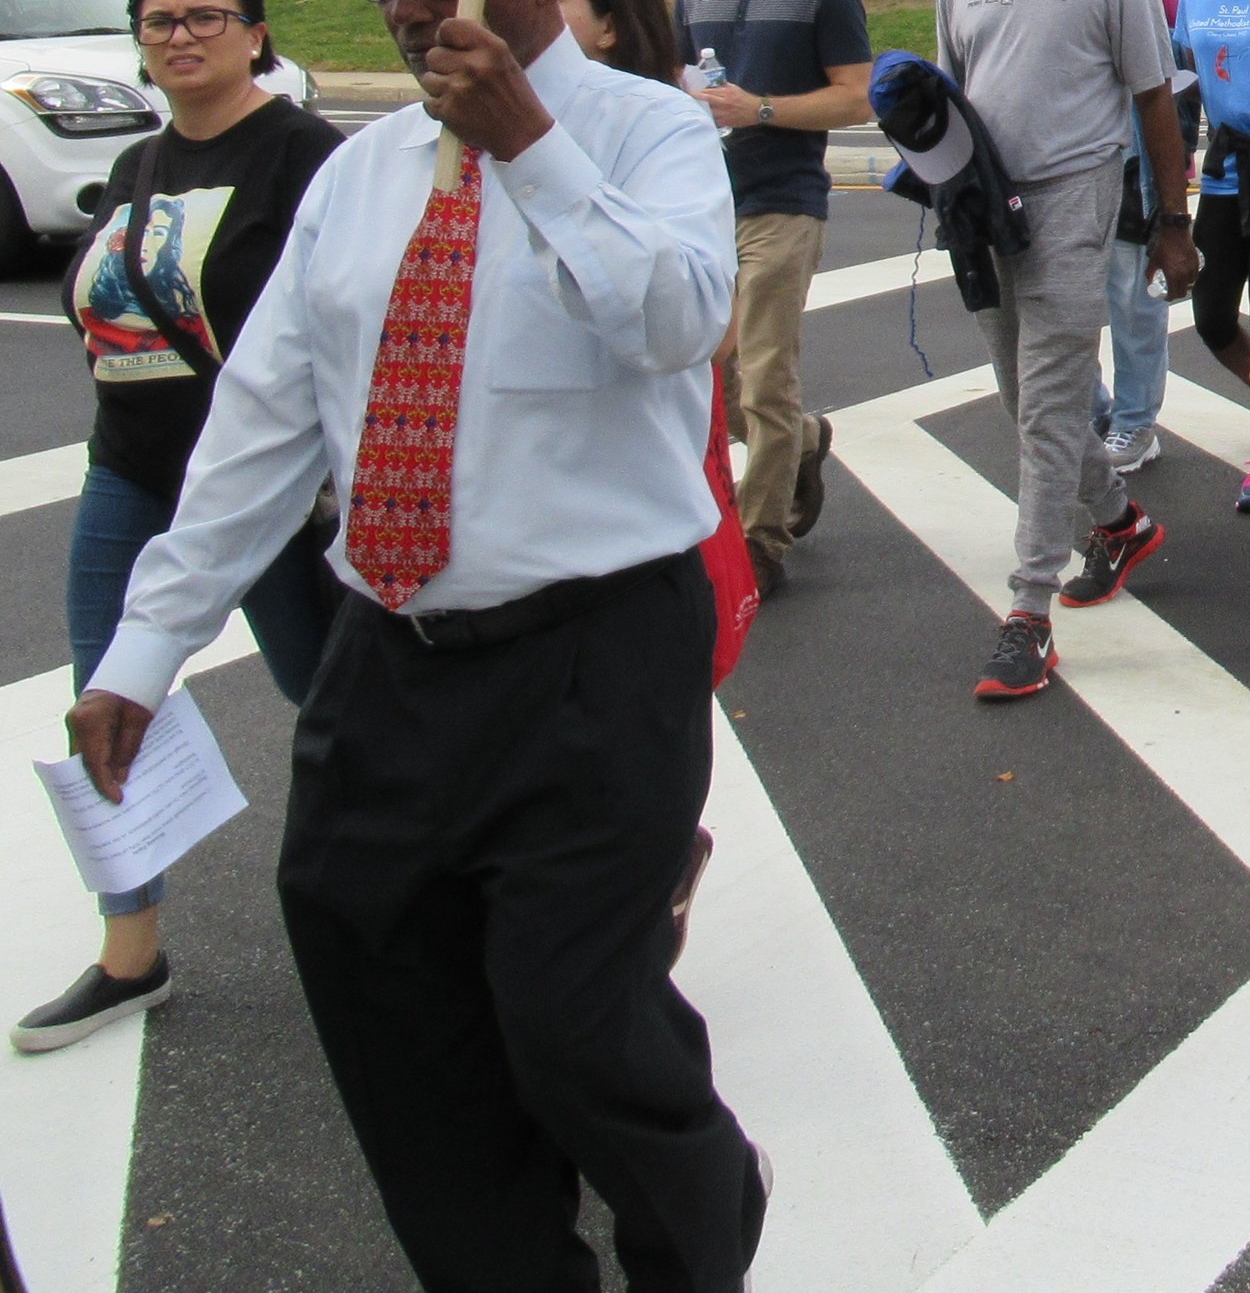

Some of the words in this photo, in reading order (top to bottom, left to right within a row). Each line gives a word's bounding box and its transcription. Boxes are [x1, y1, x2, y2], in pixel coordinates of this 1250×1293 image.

[1232, 5, 1249, 15] Paul
[1211, 18, 1249, 28] Methodist
[120, 356, 143, 368] THE
[148, 352, 180, 365] PEO
